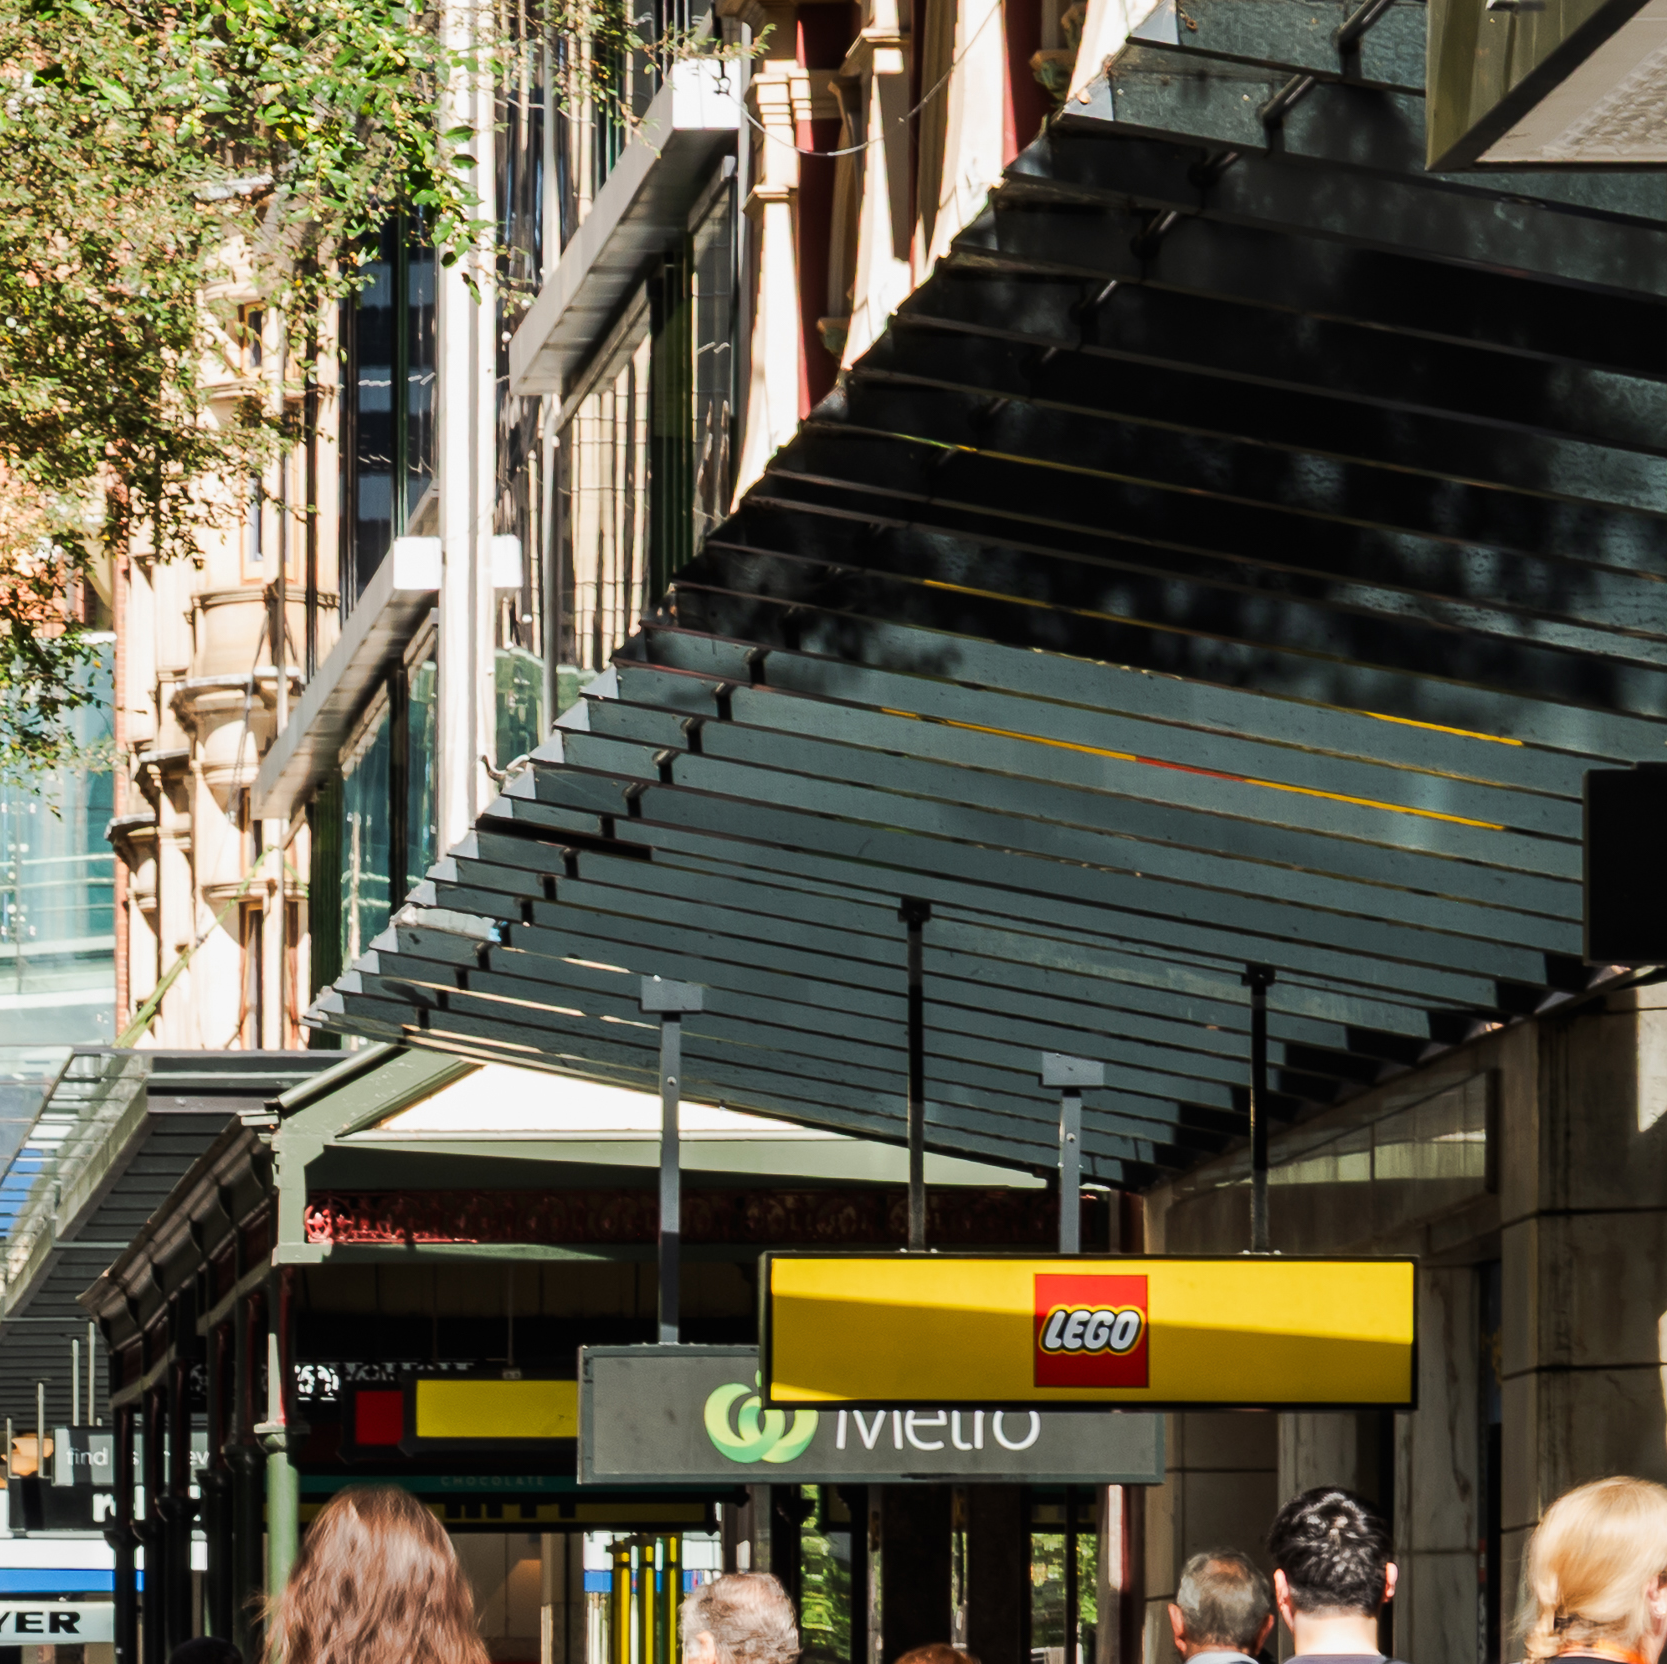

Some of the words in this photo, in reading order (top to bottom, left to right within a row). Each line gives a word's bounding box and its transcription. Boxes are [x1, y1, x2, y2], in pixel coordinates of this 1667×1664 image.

[1044, 1309, 1142, 1351] LEGO
[66, 1447, 109, 1466] find
[440, 1475, 546, 1487] CHOCOLATE
